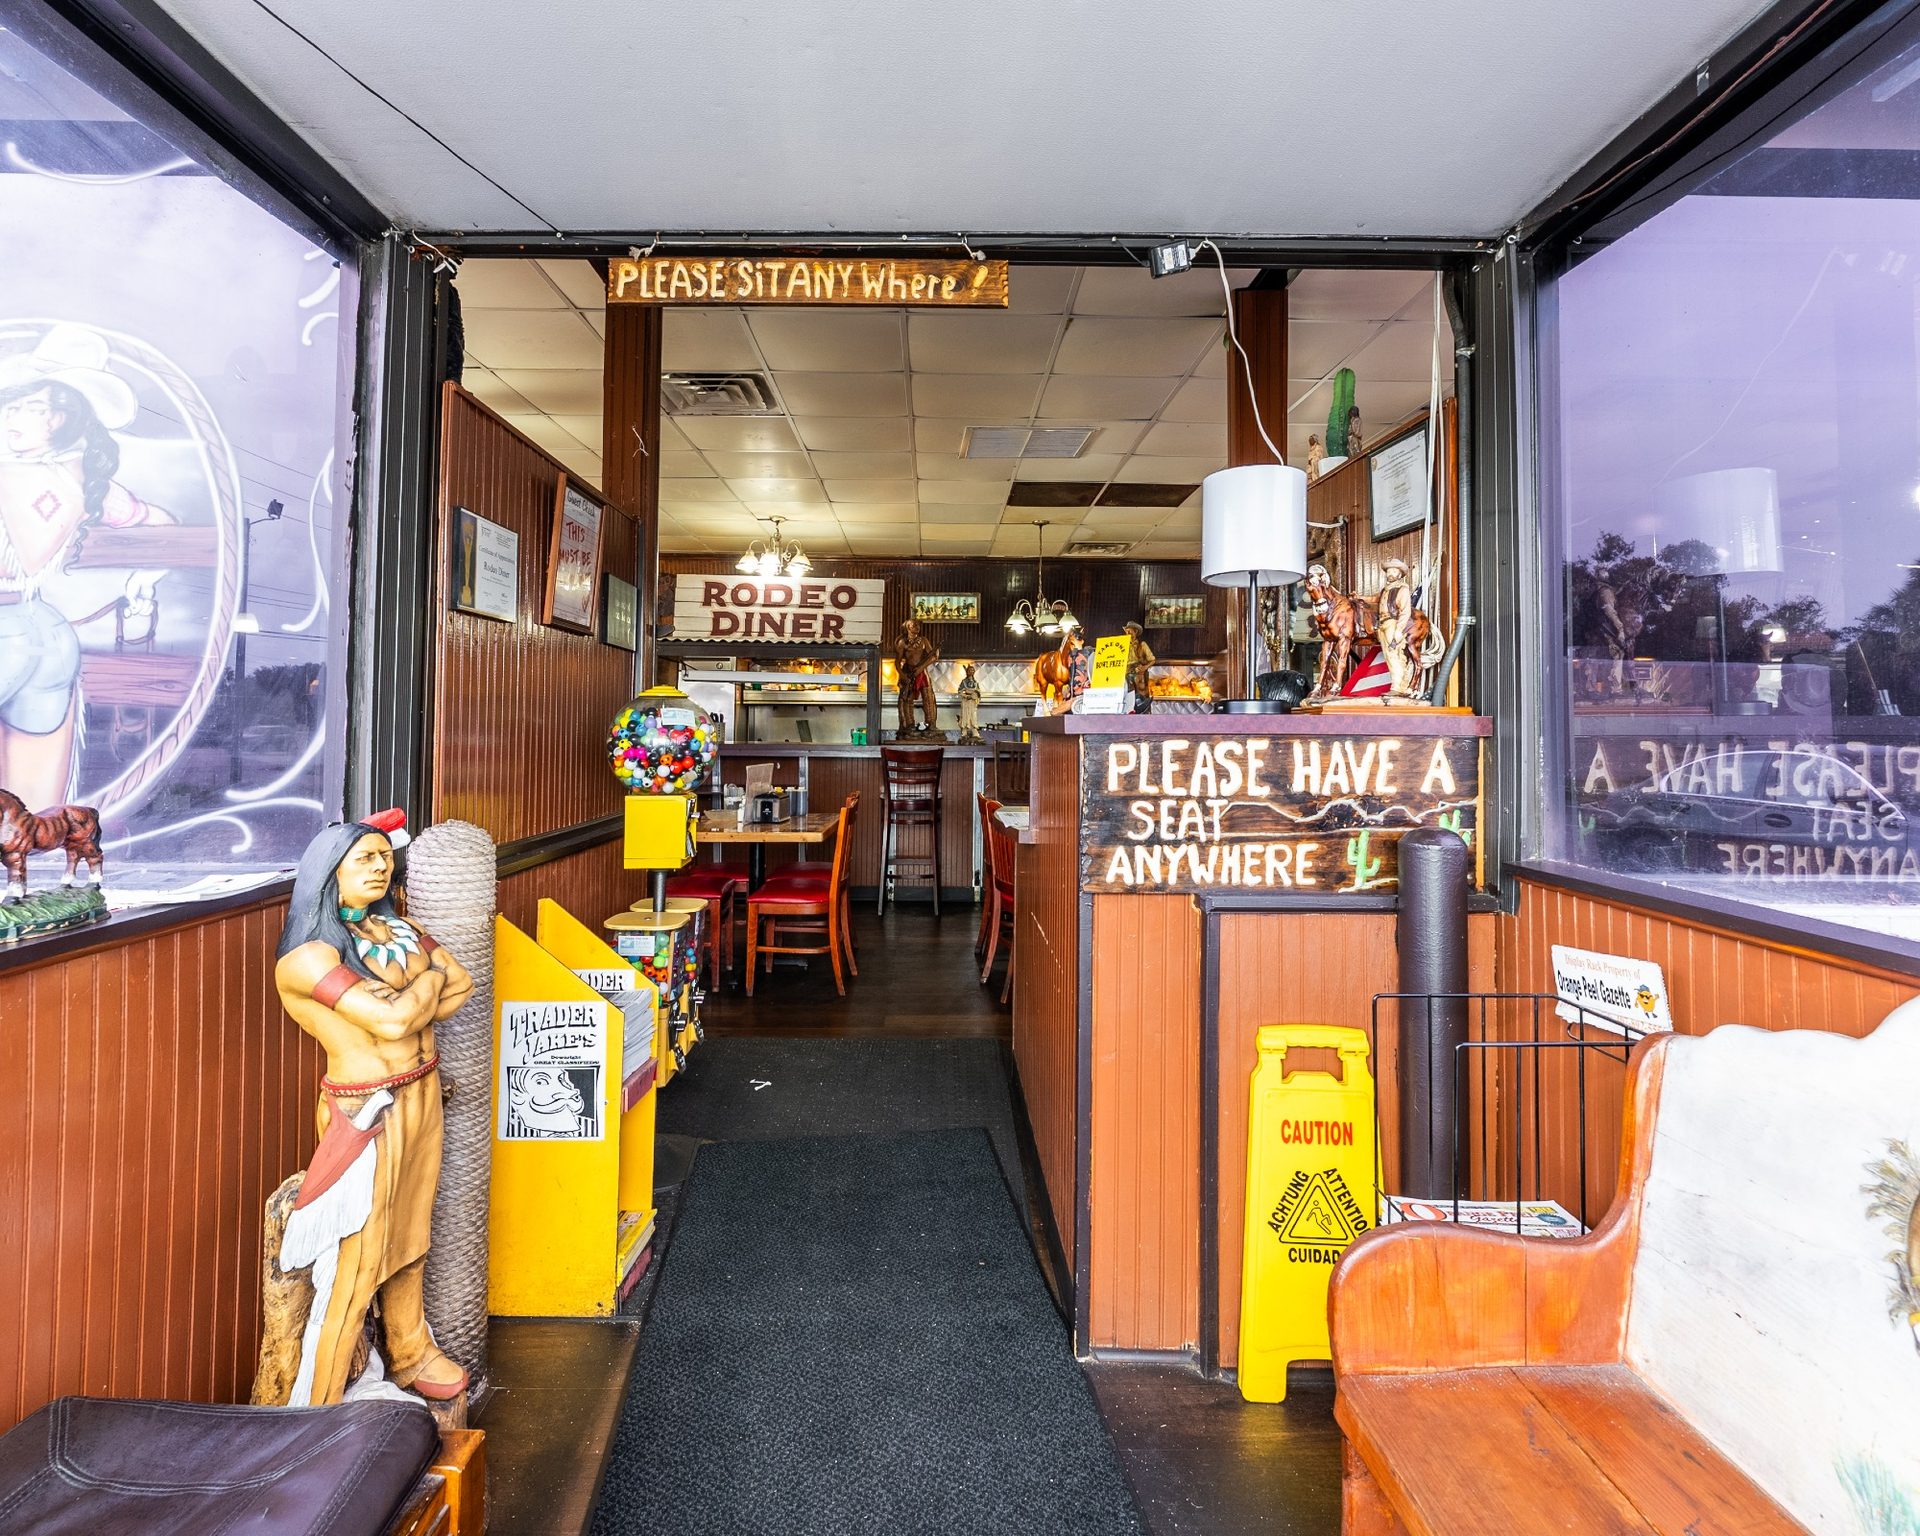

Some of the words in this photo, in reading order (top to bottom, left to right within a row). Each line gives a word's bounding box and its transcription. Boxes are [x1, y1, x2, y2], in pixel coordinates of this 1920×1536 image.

[616, 261, 725, 298] PLEASE
[566, 521, 586, 543] THIS
[558, 549, 579, 567] MUST
[581, 551, 592, 567] BE
[702, 581, 857, 610] RODEO
[711, 611, 845, 639] DINER
[1096, 661, 1109, 669] BOWL
[1108, 739, 1271, 797] PLEASE
[1293, 739, 1401, 796] HAVE
[1420, 738, 1456, 795] A
[1127, 799, 1228, 843] SEAT
[1105, 843, 1319, 887] ANYWHERE
[1558, 970, 1583, 1001] Orange
[1582, 976, 1600, 1001] Peel
[1600, 980, 1631, 1010] Gazette
[510, 1004, 597, 1049] TRADER
[522, 1032, 597, 1065] JAKE'S
[1281, 1119, 1353, 1146] CAUTION
[1267, 1170, 1310, 1233] ACHTUNG
[1288, 1247, 1341, 1265] CUIDAD
